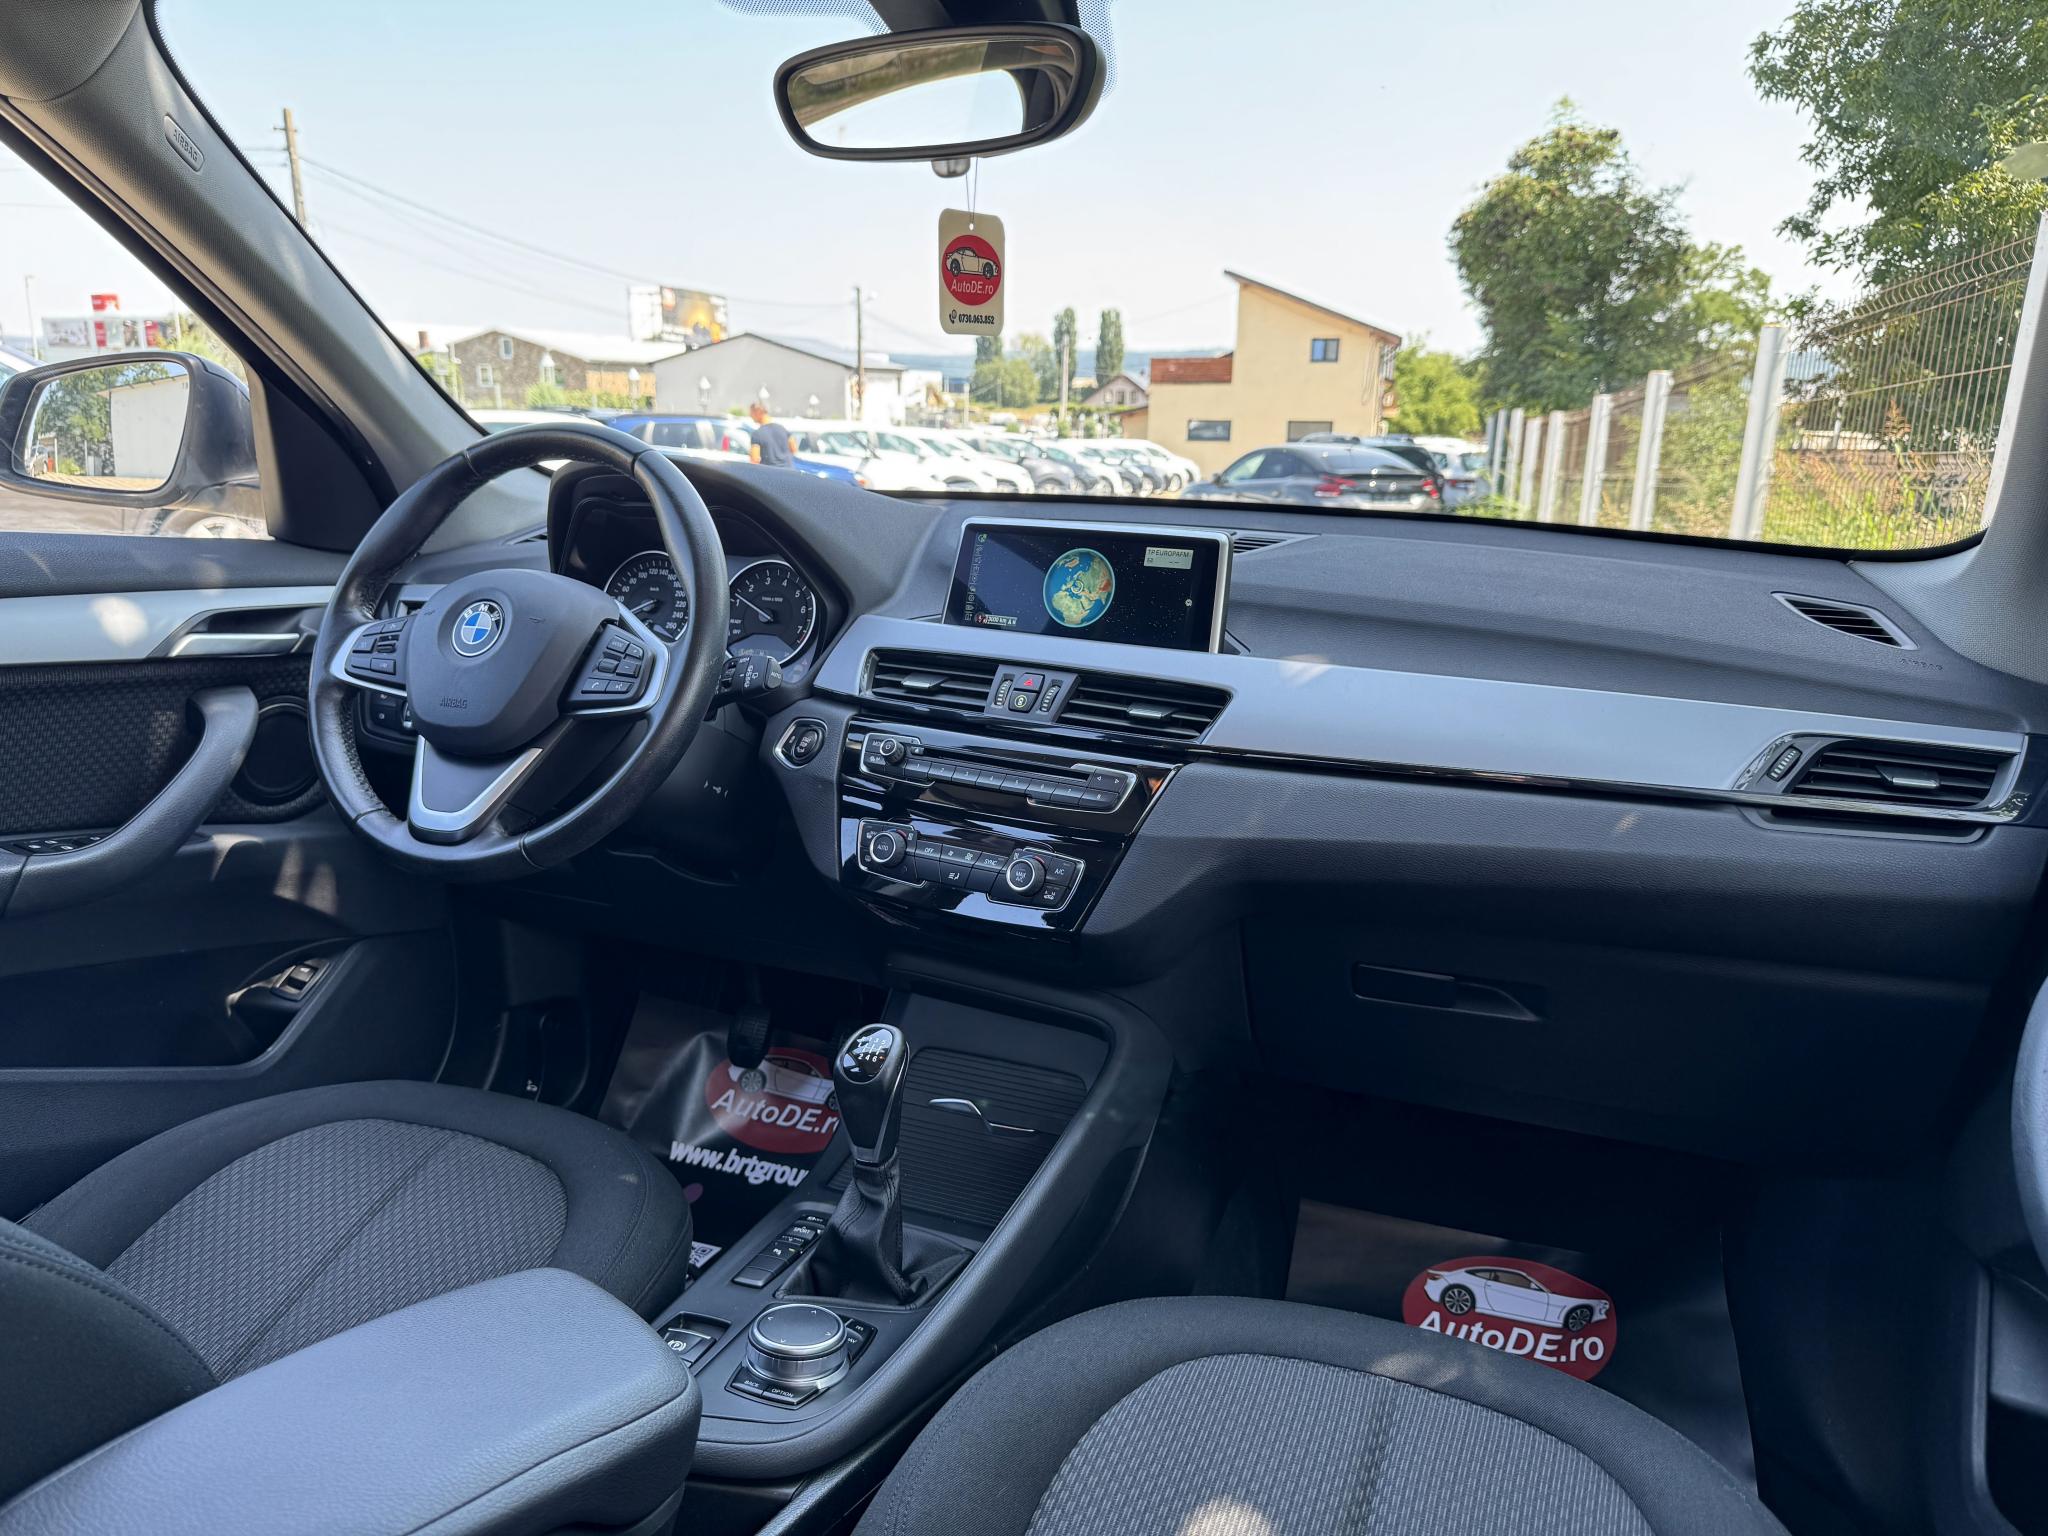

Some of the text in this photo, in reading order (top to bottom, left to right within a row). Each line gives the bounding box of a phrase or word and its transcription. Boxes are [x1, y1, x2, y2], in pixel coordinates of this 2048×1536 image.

[173, 129, 198, 162] AIRBAG
[951, 279, 994, 295] AutoDE.ro
[765, 577, 771, 585] 3
[782, 579, 788, 587] 4
[748, 584, 754, 592] 2
[674, 590, 686, 598] 200
[795, 590, 801, 598] 5
[463, 602, 501, 622] BMW
[671, 611, 684, 619] 240
[665, 621, 677, 629] 260
[797, 625, 803, 634] 7
[669, 1140, 809, 1187] www.brtgrou
[1418, 1310, 1605, 1363] AutoDE.ro
[744, 1380, 760, 1388] BACK
[771, 1388, 795, 1398] OPTION
